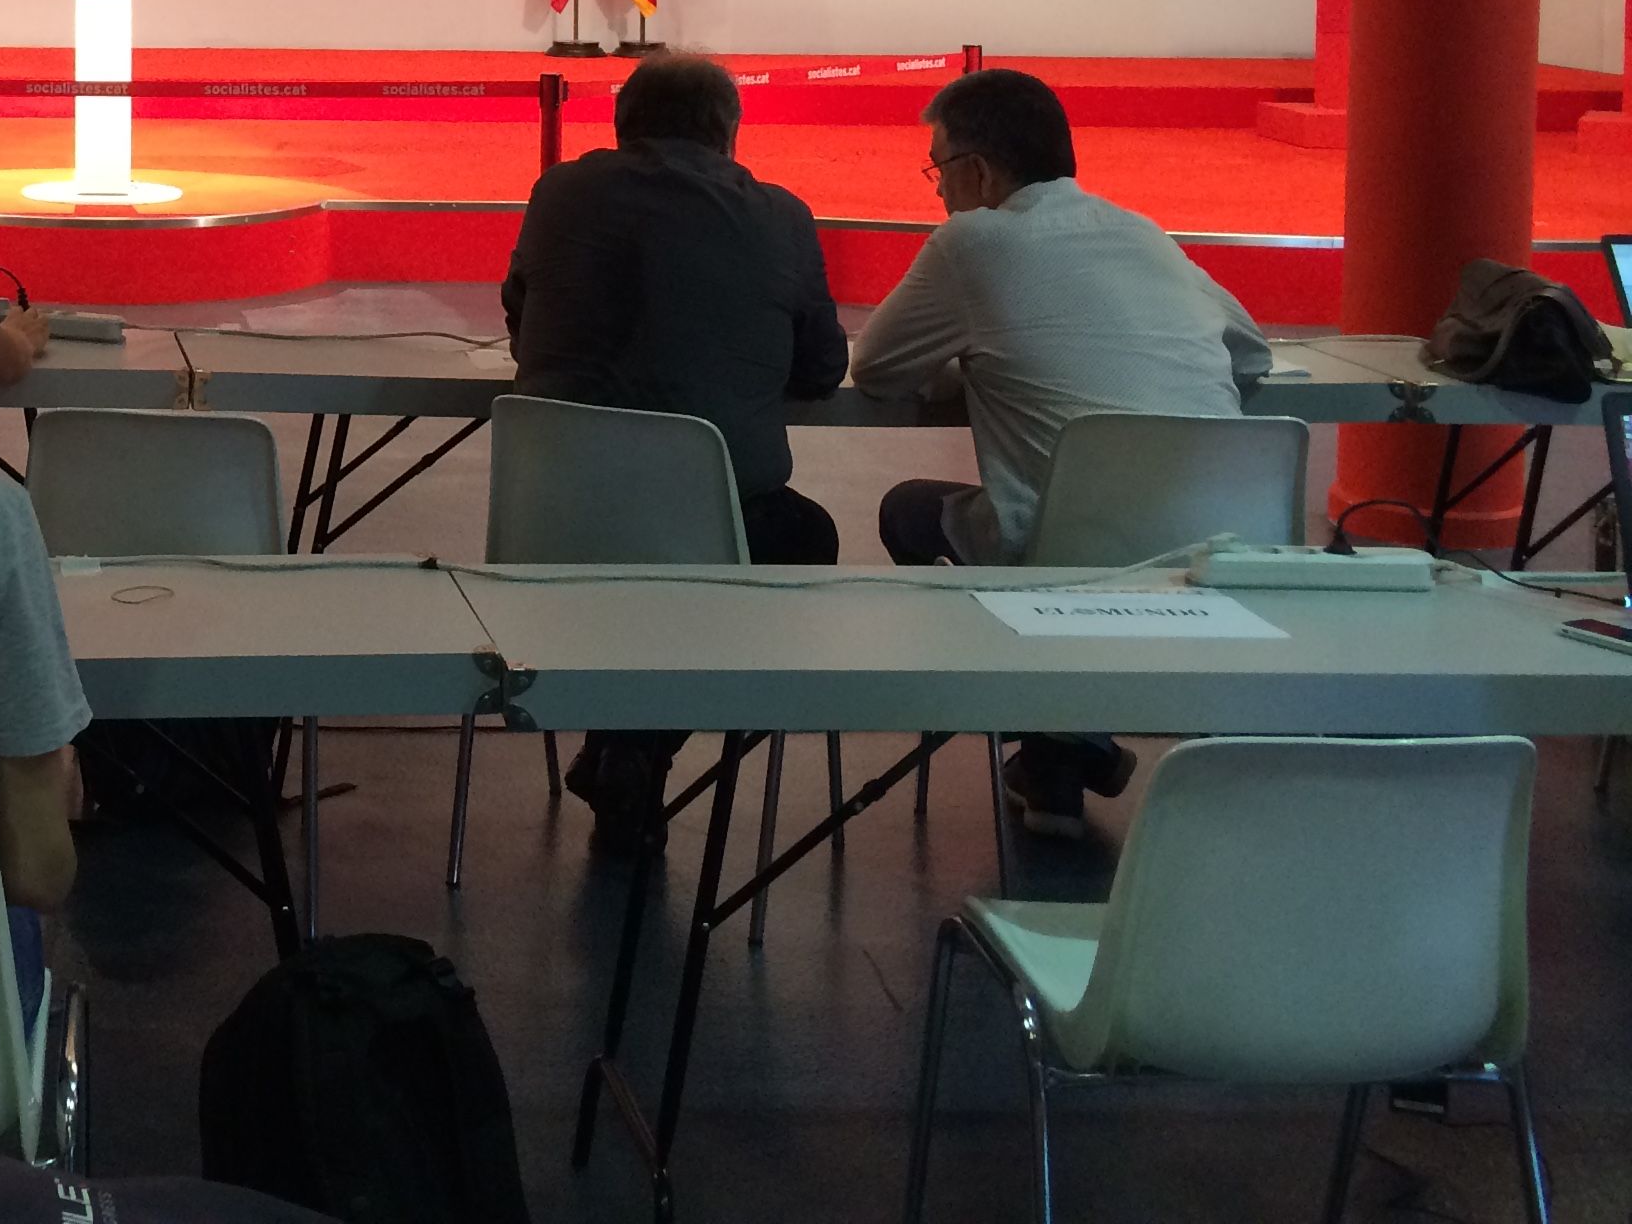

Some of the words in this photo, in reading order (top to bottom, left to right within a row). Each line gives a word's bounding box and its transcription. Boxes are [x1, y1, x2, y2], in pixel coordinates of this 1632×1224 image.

[25, 82, 129, 96] socialistes.cat
[203, 83, 307, 96] socialistes.cat
[382, 83, 486, 96] socialistes.cat
